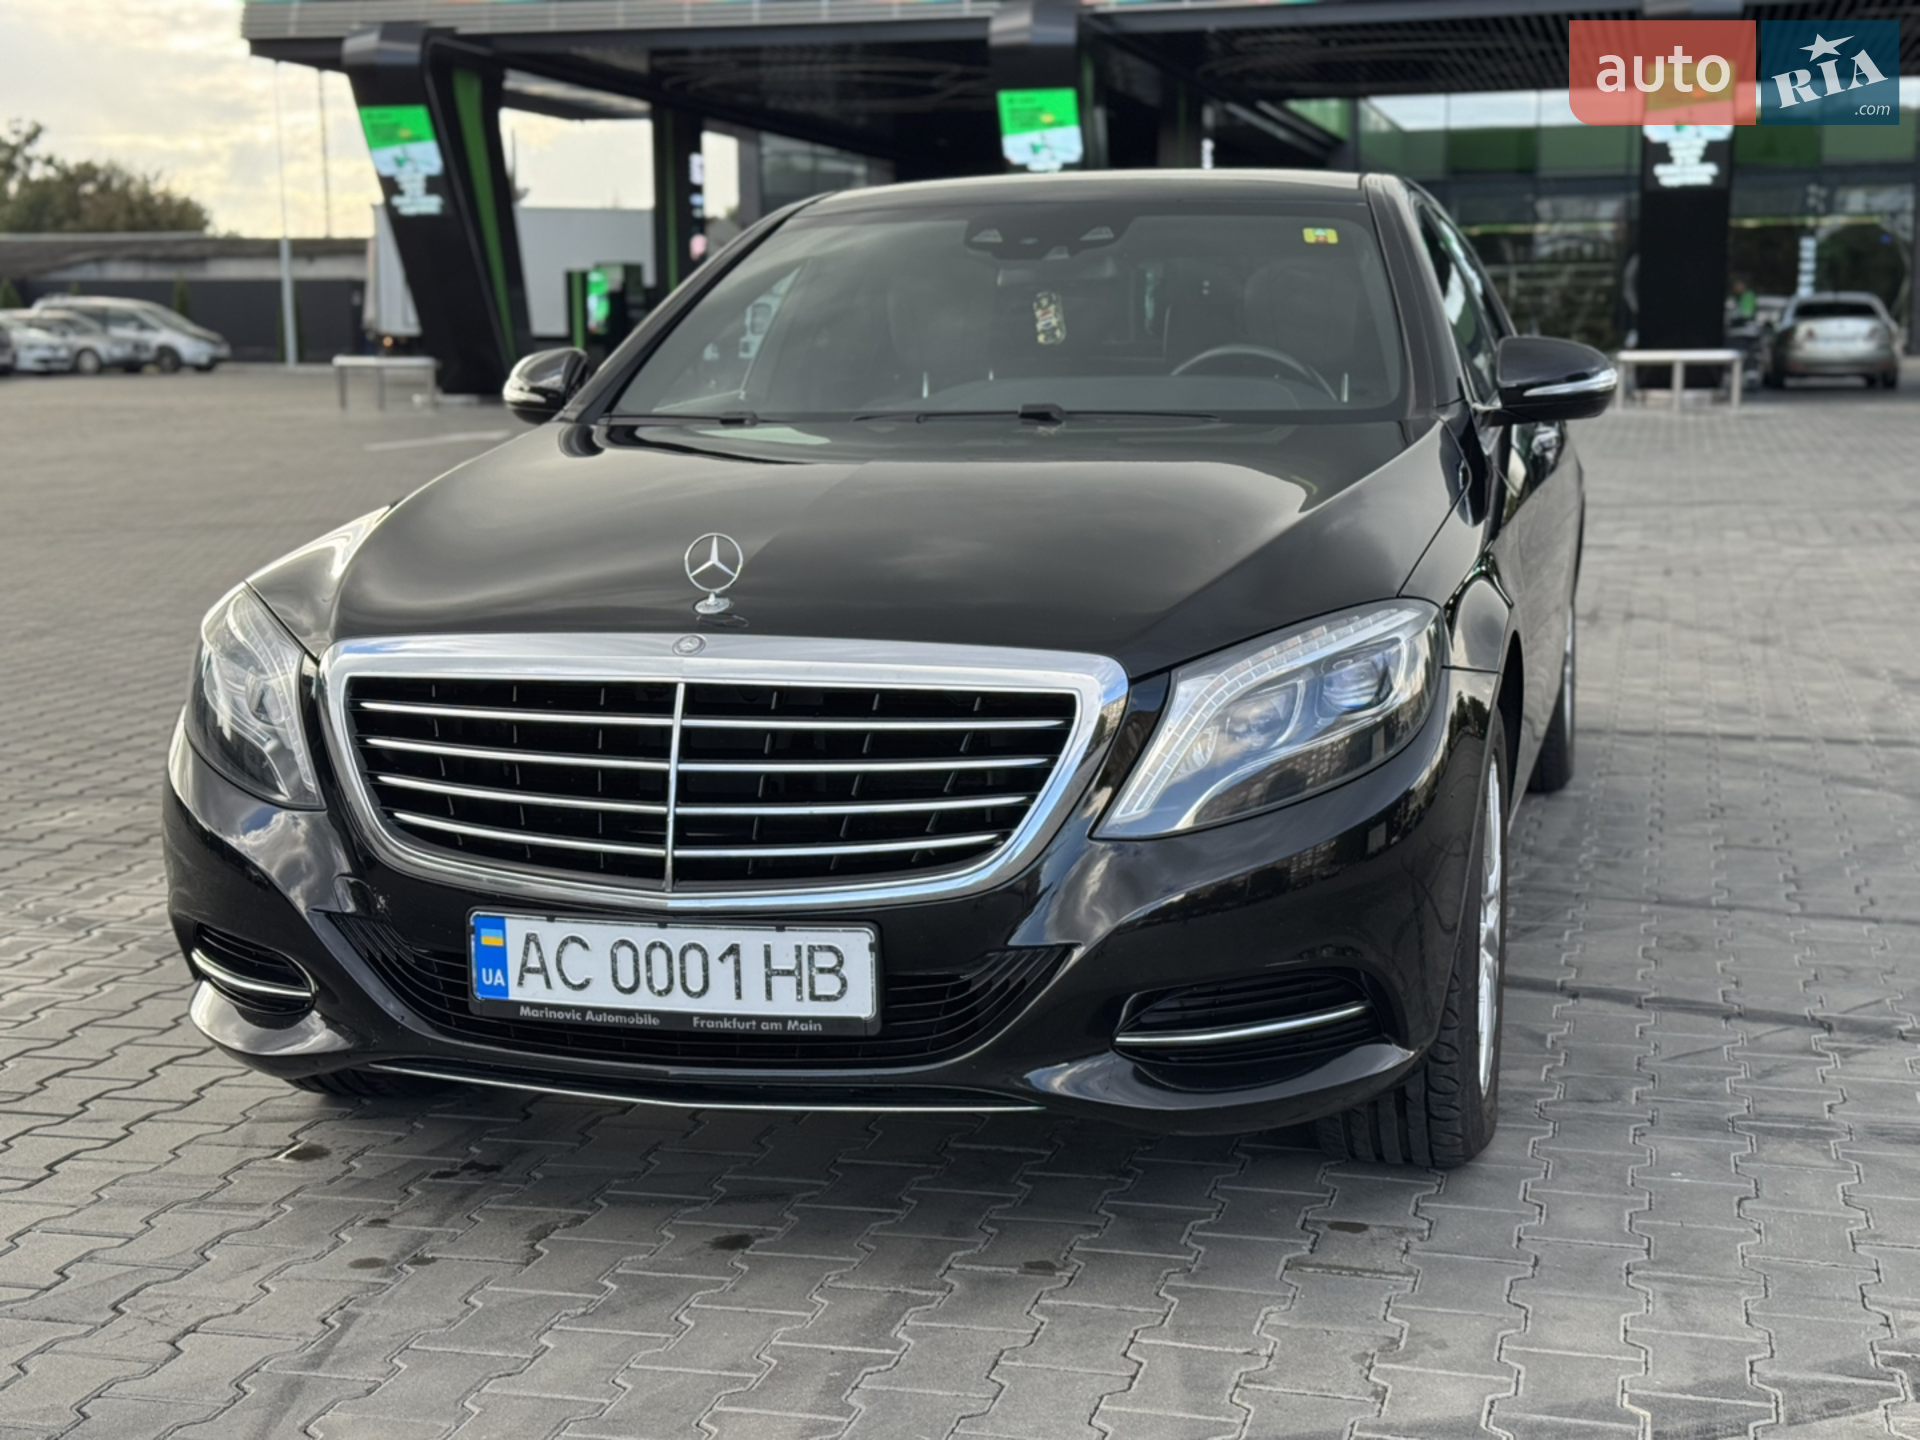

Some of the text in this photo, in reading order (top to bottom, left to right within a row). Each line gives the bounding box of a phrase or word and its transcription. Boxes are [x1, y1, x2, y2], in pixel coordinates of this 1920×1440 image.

[482, 967, 506, 986] UA
[517, 932, 849, 1002] AC 0001 HB
[519, 1005, 660, 1026] Marinovic Automobile
[692, 1017, 823, 1032] Frankfurt am Main
